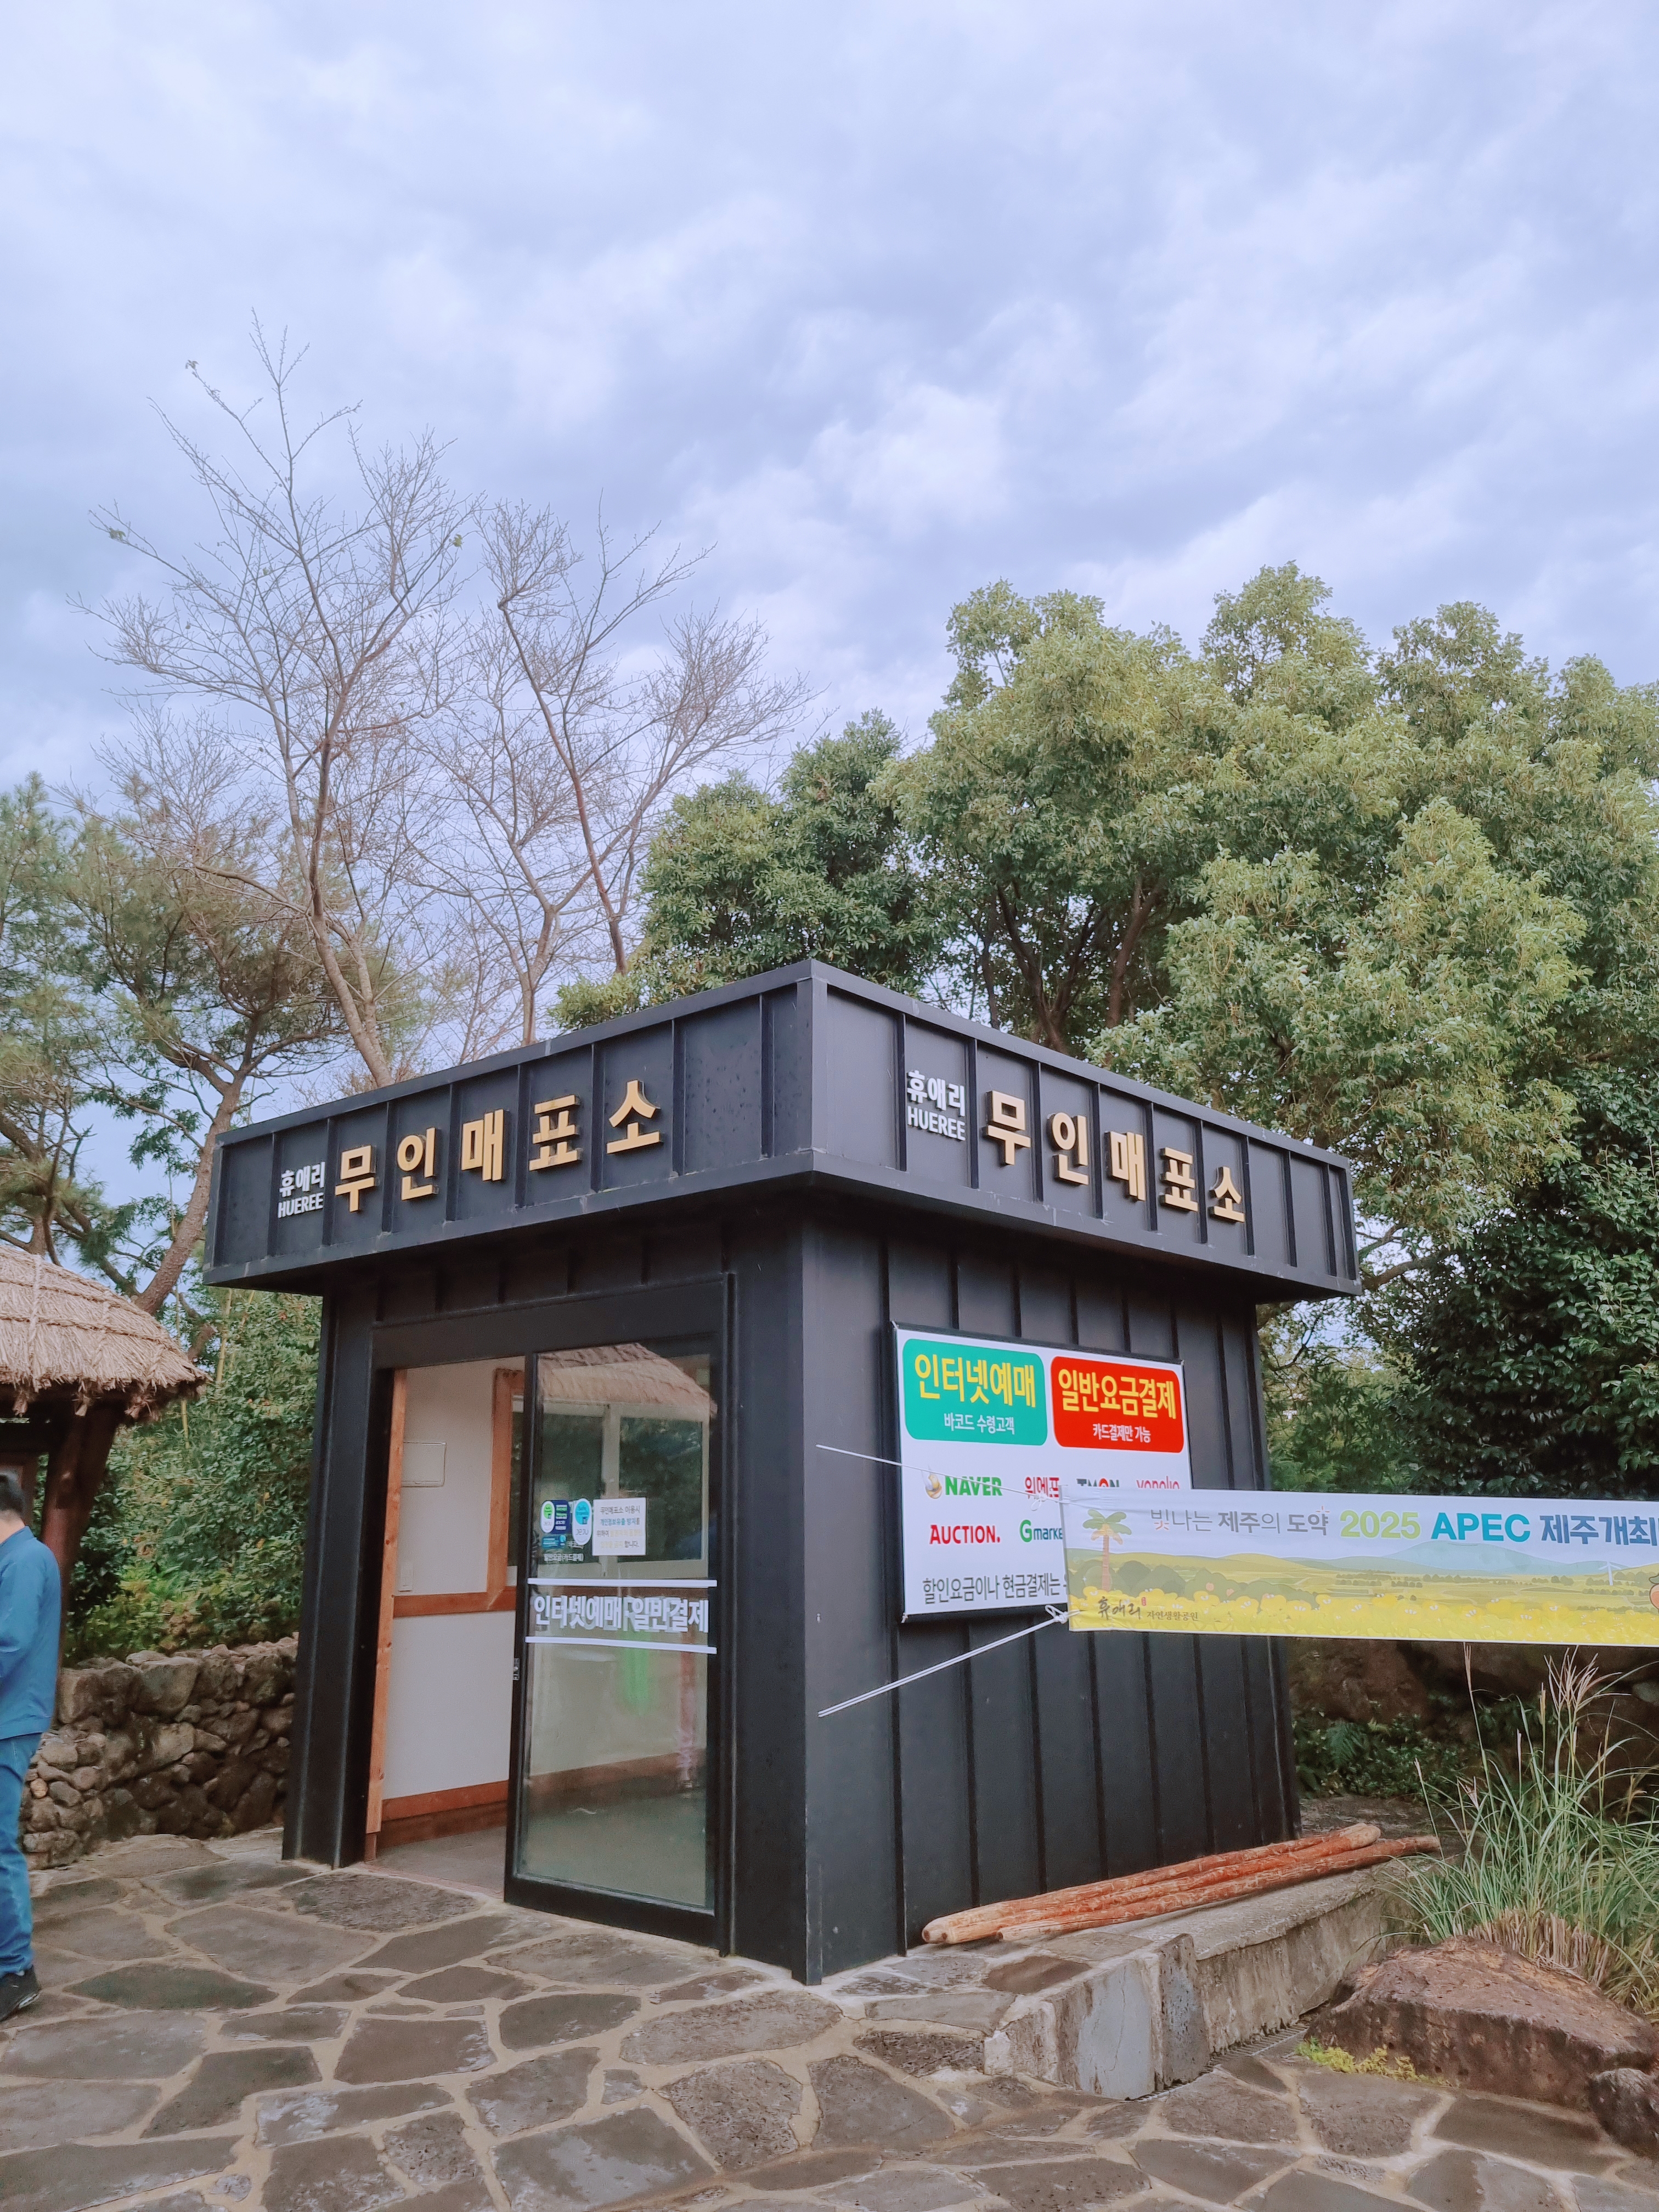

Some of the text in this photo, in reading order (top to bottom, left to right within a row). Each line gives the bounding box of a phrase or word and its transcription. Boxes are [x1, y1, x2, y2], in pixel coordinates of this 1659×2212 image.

[907, 1070, 965, 1117] 휴애리
[907, 1105, 966, 1141] HUEREE
[335, 1080, 660, 1212] 무인매표소
[986, 1090, 1245, 1222] 무인매표소
[279, 1161, 325, 1198] 휴애리
[278, 1192, 324, 1218] HUEREE
[915, 1354, 1036, 1408] 인터넷예매
[1058, 1369, 1176, 1419] 일반요금결제
[944, 1412, 1015, 1435] 바코드 수령고객
[1092, 1423, 1151, 1443] 카드결제만 가능
[945, 1476, 1003, 1496] NAVER
[1019, 1519, 1063, 1543] Gmarke
[1151, 1509, 1659, 1547] 빛나는 제주의 도약 2025 APEC 제주개최
[923, 1575, 1000, 1604] 할인요금이나
[1002, 1572, 1061, 1599] 현금결제는
[1146, 1611, 1199, 1621] 자연생활공원
